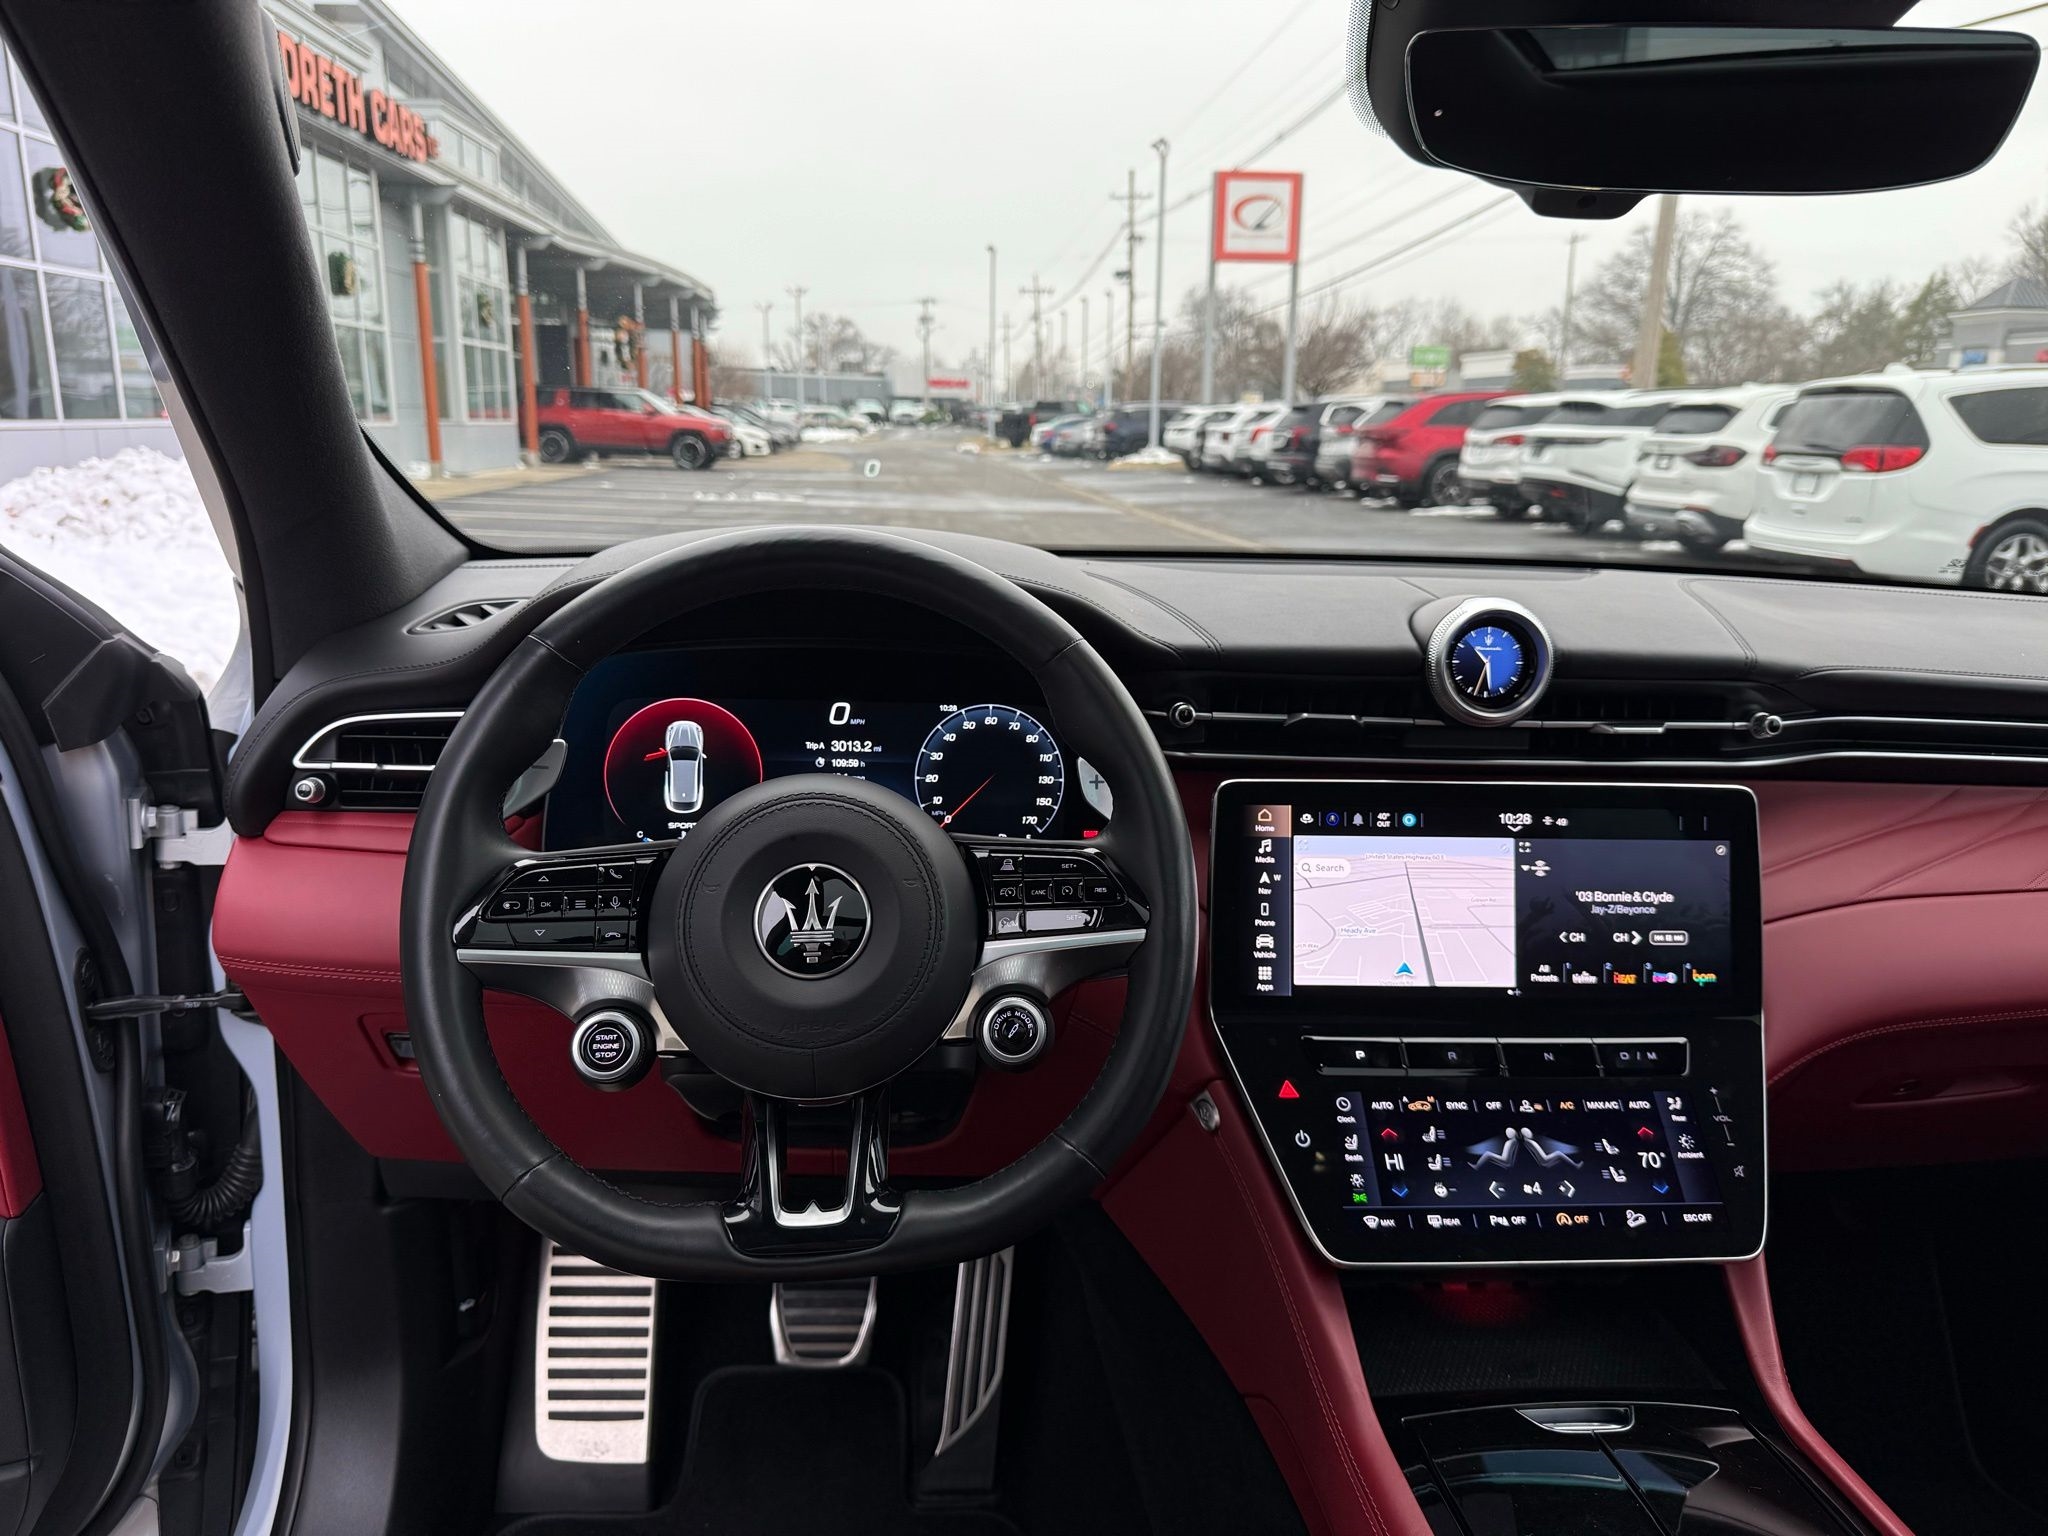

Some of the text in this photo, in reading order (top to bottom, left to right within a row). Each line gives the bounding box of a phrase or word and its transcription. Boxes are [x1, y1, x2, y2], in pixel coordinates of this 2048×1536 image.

[370, 88, 427, 163] CARS
[864, 459, 881, 478] 0
[829, 702, 851, 725] 0
[984, 717, 998, 725] 60
[1008, 722, 1020, 730] 70
[805, 742, 819, 751] Trip
[831, 740, 873, 752] 3013.2
[1039, 754, 1052, 762] 110
[831, 759, 859, 767] 109:59
[1038, 776, 1054, 784] 130
[944, 815, 952, 823] 0
[1022, 816, 1038, 824] 170
[1499, 813, 1533, 825] 10:28
[1555, 818, 1569, 826] 49
[1255, 856, 1275, 864] Media
[1316, 864, 1344, 872] Search
[1595, 891, 1631, 902] Bonnie
[1632, 892, 1642, 902] &
[1643, 892, 1674, 904] Clyde
[1255, 919, 1276, 927] Phone
[1569, 933, 1586, 942] CH
[1613, 933, 1629, 942] CH
[1253, 951, 1277, 959] Vehicle
[1539, 964, 1550, 973] All
[1531, 973, 1559, 983] Presets
[1693, 969, 1717, 986] bpm
[1256, 984, 1274, 992] Apps
[994, 1011, 1033, 1029] DRIVE MODE
[1355, 1050, 1365, 1060] P
[1448, 1051, 1457, 1060] R
[1544, 1052, 1555, 1061] N
[1371, 1102, 1394, 1110] AUTO
[1446, 1102, 1468, 1110] SYNC
[1485, 1102, 1502, 1110] OFF
[1560, 1101, 1575, 1110] A/C
[1629, 1101, 1651, 1109] AUTO
[1345, 1154, 1364, 1162] Seats
[1638, 1152, 1665, 1169] 70°
[1385, 1154, 1405, 1171] HI
[1532, 1182, 1543, 1195] 4
[1443, 1218, 1461, 1226] REAR
[1511, 1216, 1527, 1225] OFF
[1574, 1215, 1589, 1224] OFF
[1683, 1214, 1712, 1222] ESC OFF
[1380, 1219, 1396, 1227] MAX
